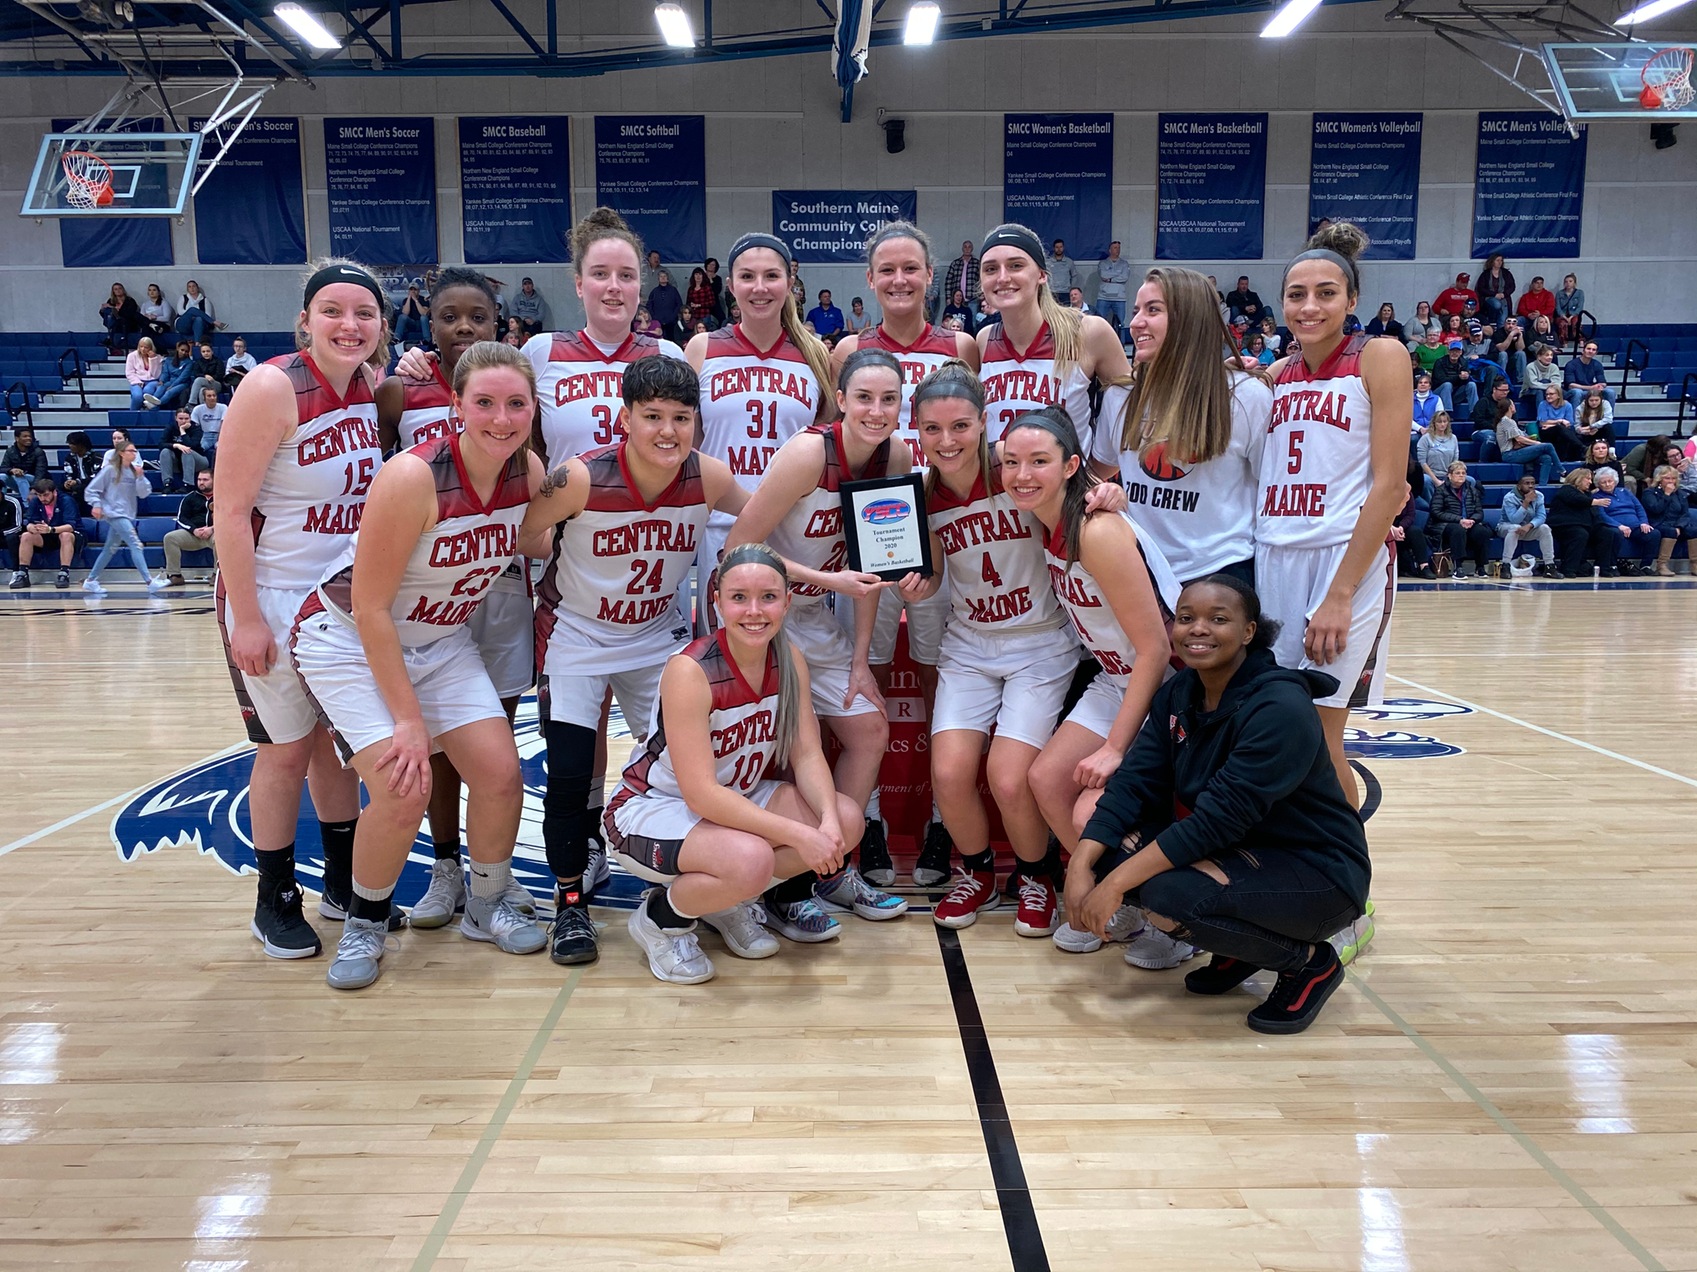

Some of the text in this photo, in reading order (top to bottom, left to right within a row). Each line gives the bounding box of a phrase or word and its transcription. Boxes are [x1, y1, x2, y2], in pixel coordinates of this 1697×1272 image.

[264, 121, 293, 131] Soccer
[340, 127, 420, 138] SMCC Men's Soccer
[483, 125, 546, 137] SMCC Baseball
[621, 125, 680, 136] SMCC Softball
[1008, 122, 1111, 134] SMCC Women's Basketball
[1164, 122, 1262, 133] SMCC Men's Basketball
[1316, 121, 1421, 135] SMCC Women's Volleyball
[1482, 121, 1508, 132] SMCC
[1510, 121, 1537, 131] Men's
[791, 202, 899, 214] Southern Maine
[780, 220, 885, 234] Community Coll
[711, 366, 812, 411] CENTRAL
[982, 370, 1067, 408] ENTRAL
[746, 399, 778, 439] 31
[1268, 390, 1351, 433] ENTRAL
[298, 418, 382, 466] CENTRA
[1288, 430, 1305, 475] 5
[340, 457, 374, 496] 15
[1152, 487, 1200, 513] CREW
[1260, 484, 1327, 517] MAINE
[429, 524, 519, 568] CENTRA
[592, 520, 697, 557] CENTRAL
[873, 527, 906, 536] Tournament
[935, 509, 1032, 556] ENTRAL
[626, 558, 665, 595] 24
[891, 558, 914, 566] Basketball
[982, 552, 1003, 588] 4
[597, 594, 674, 624] MAINE
[965, 586, 1033, 623] MAINE
[724, 751, 764, 791] 10
[916, 781, 929, 796] of
